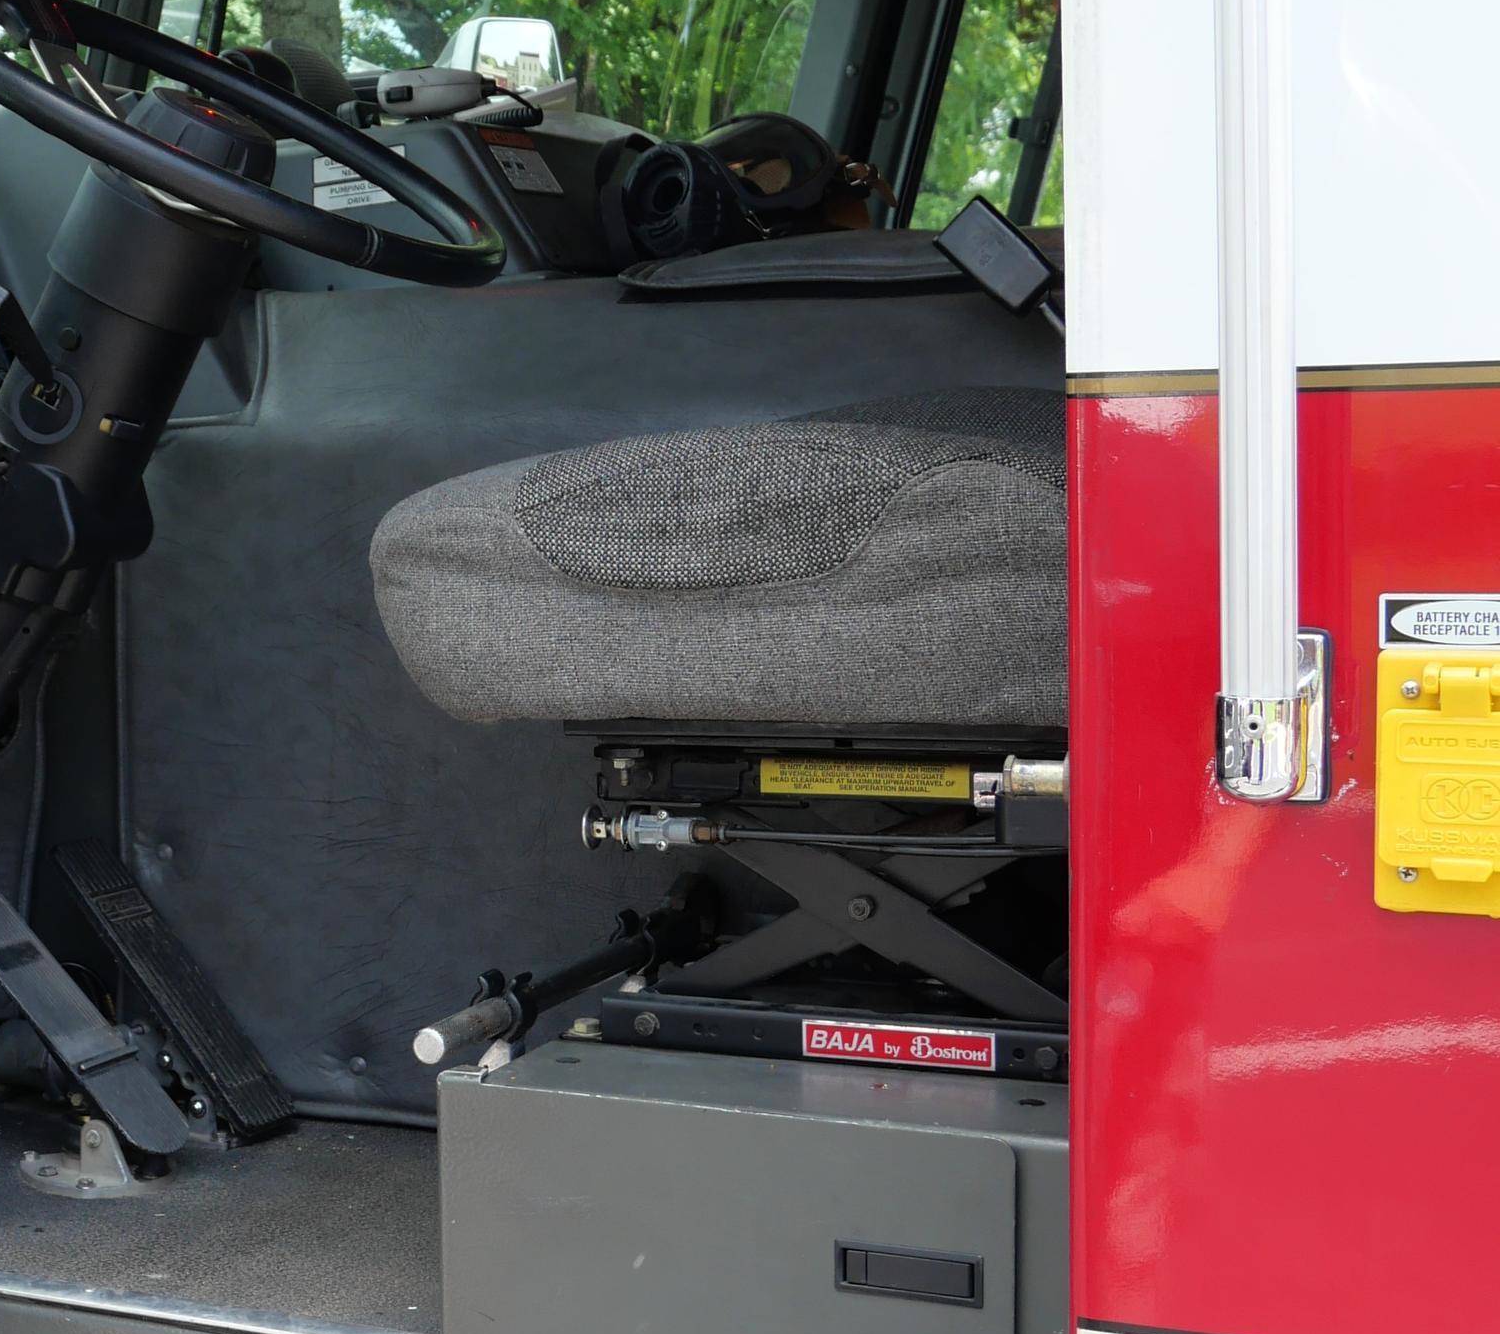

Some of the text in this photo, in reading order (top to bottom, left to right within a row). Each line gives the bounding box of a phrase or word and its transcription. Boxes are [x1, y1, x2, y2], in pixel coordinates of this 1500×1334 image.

[347, 195, 371, 205] DRIVE
[1416, 611, 1470, 623] BATTERY
[1413, 624, 1490, 636] RECEPTACLE
[1405, 736, 1460, 748] AUTO
[810, 1029, 988, 1062] BAJA by Bostrom
